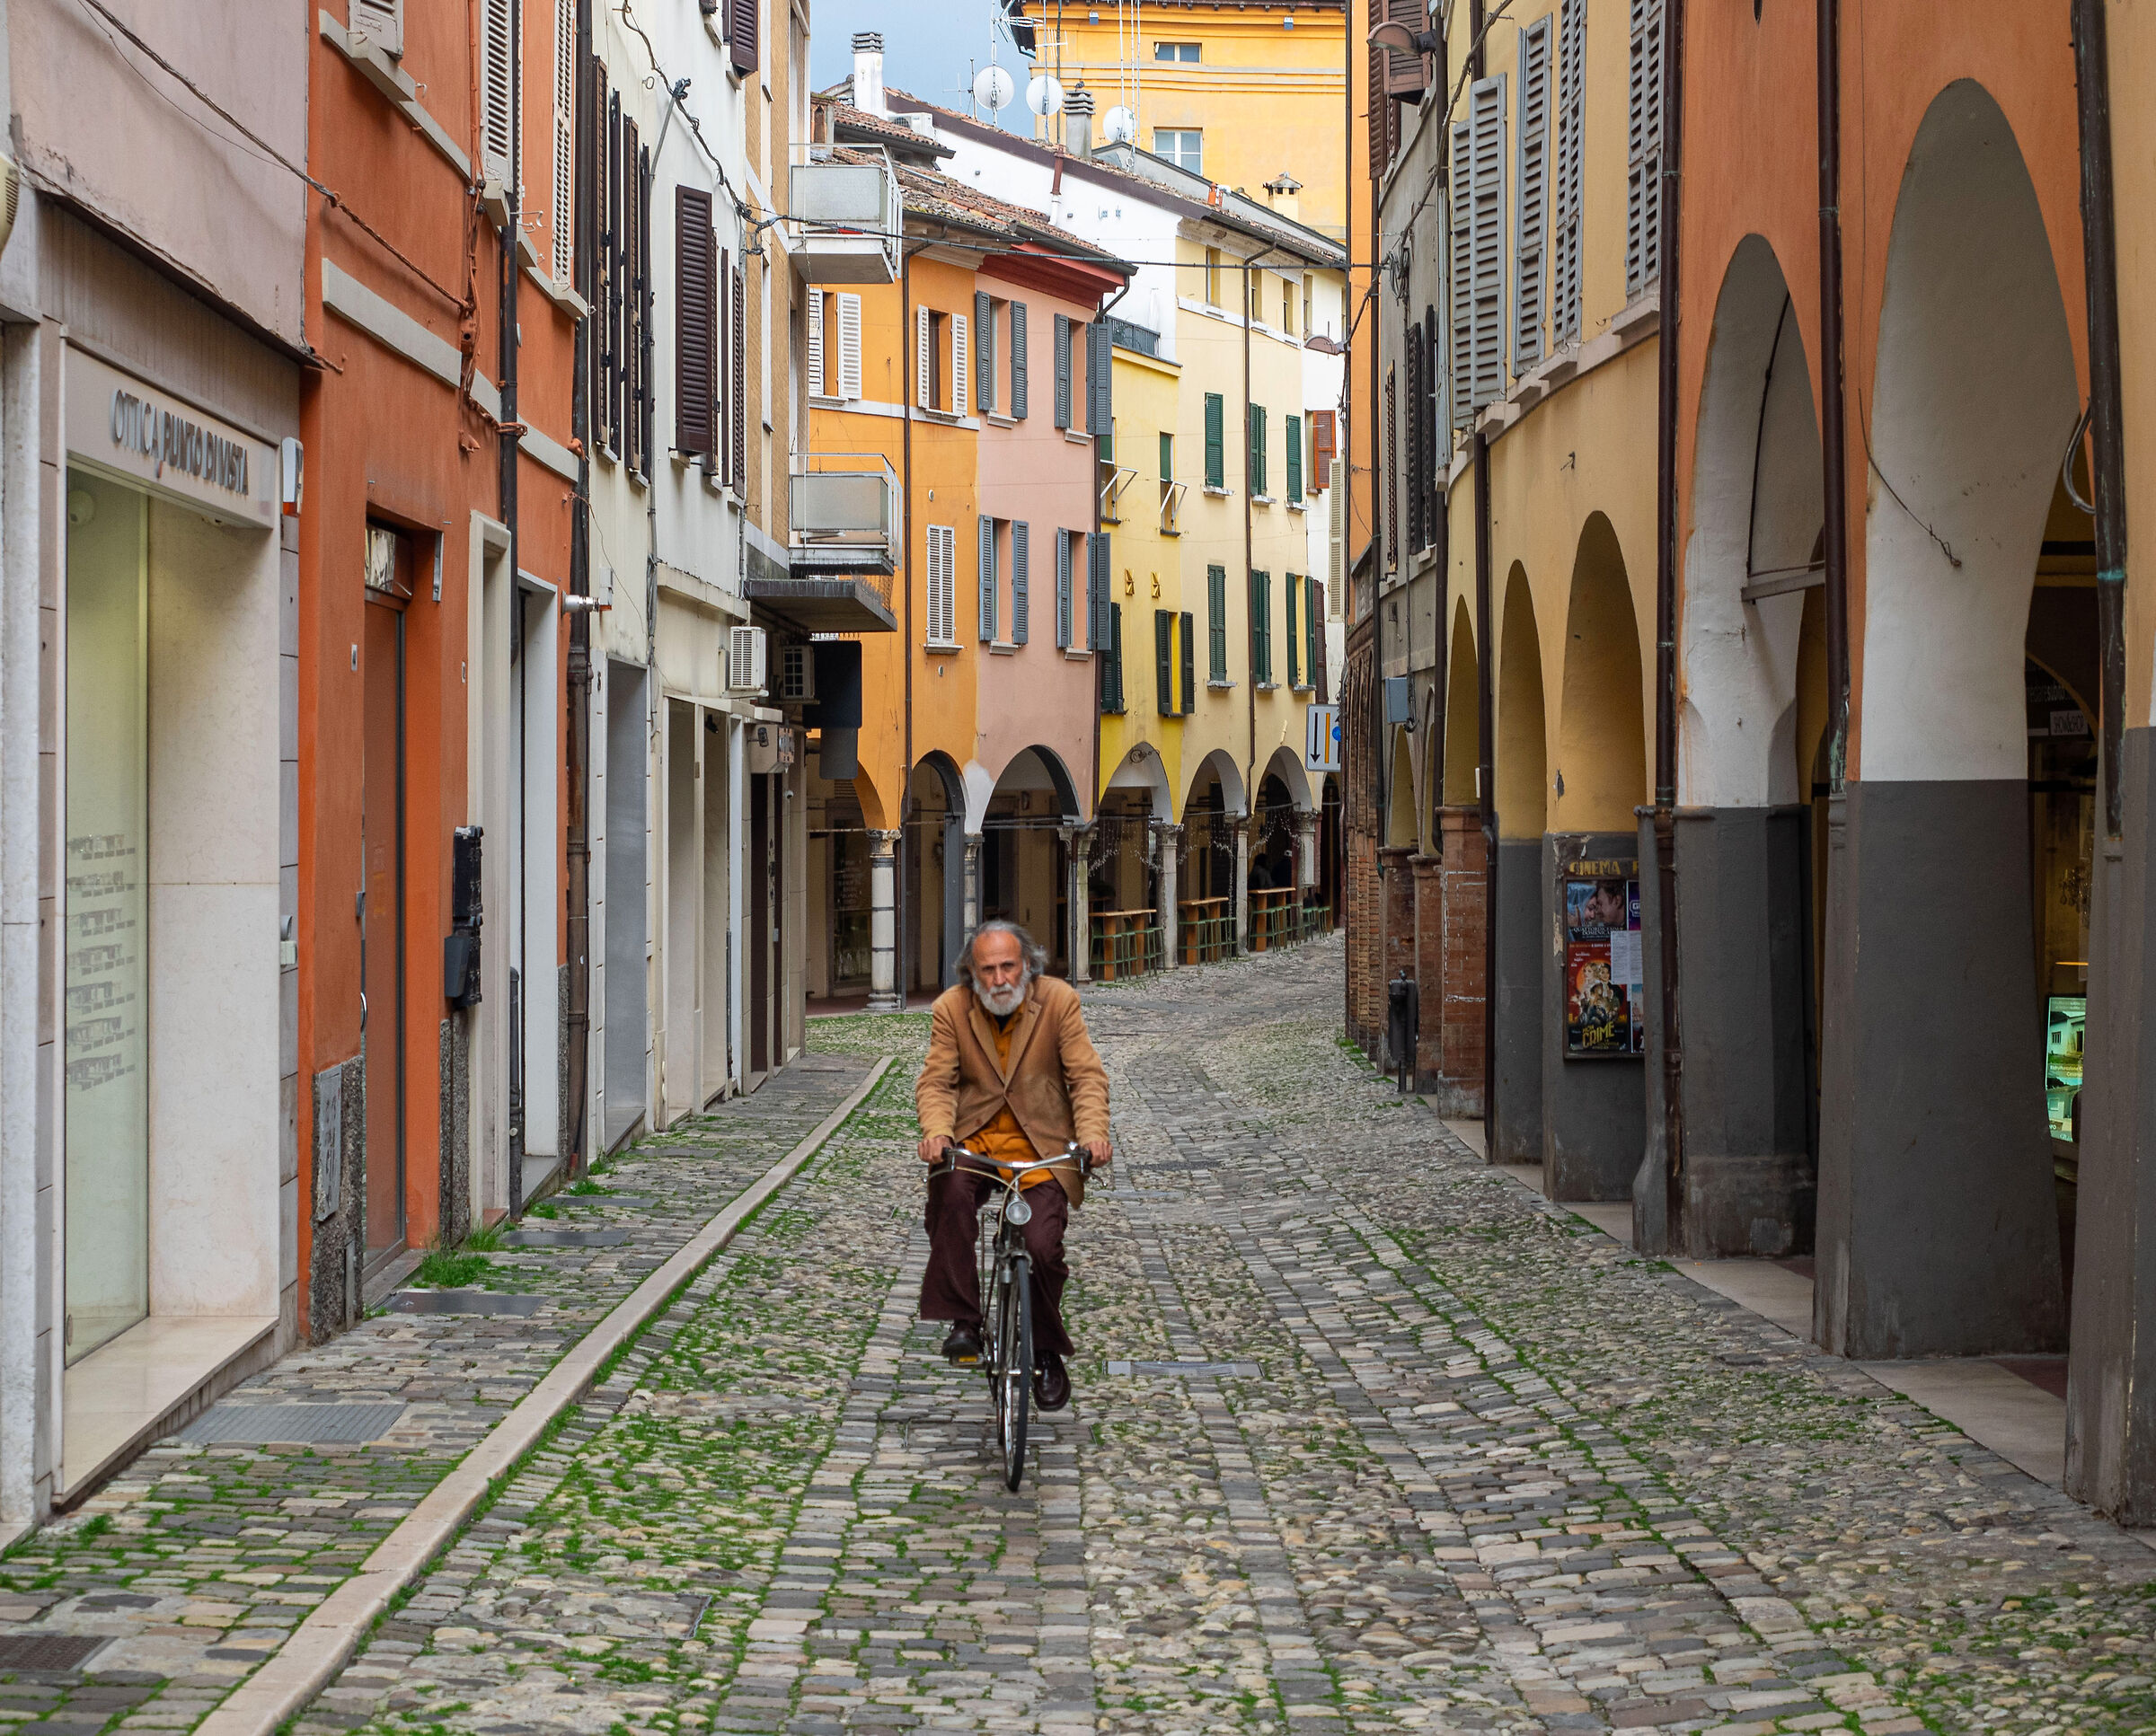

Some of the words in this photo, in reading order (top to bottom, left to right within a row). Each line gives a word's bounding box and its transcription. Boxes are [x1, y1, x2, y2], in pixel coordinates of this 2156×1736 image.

[110, 389, 159, 459] OTTICA
[160, 410, 203, 477] PUNTO
[204, 431, 217, 482] DI
[218, 437, 249, 496] VISTA
[1568, 859, 1621, 876] CINEMA
[1582, 1021, 1614, 1047] CRIME
